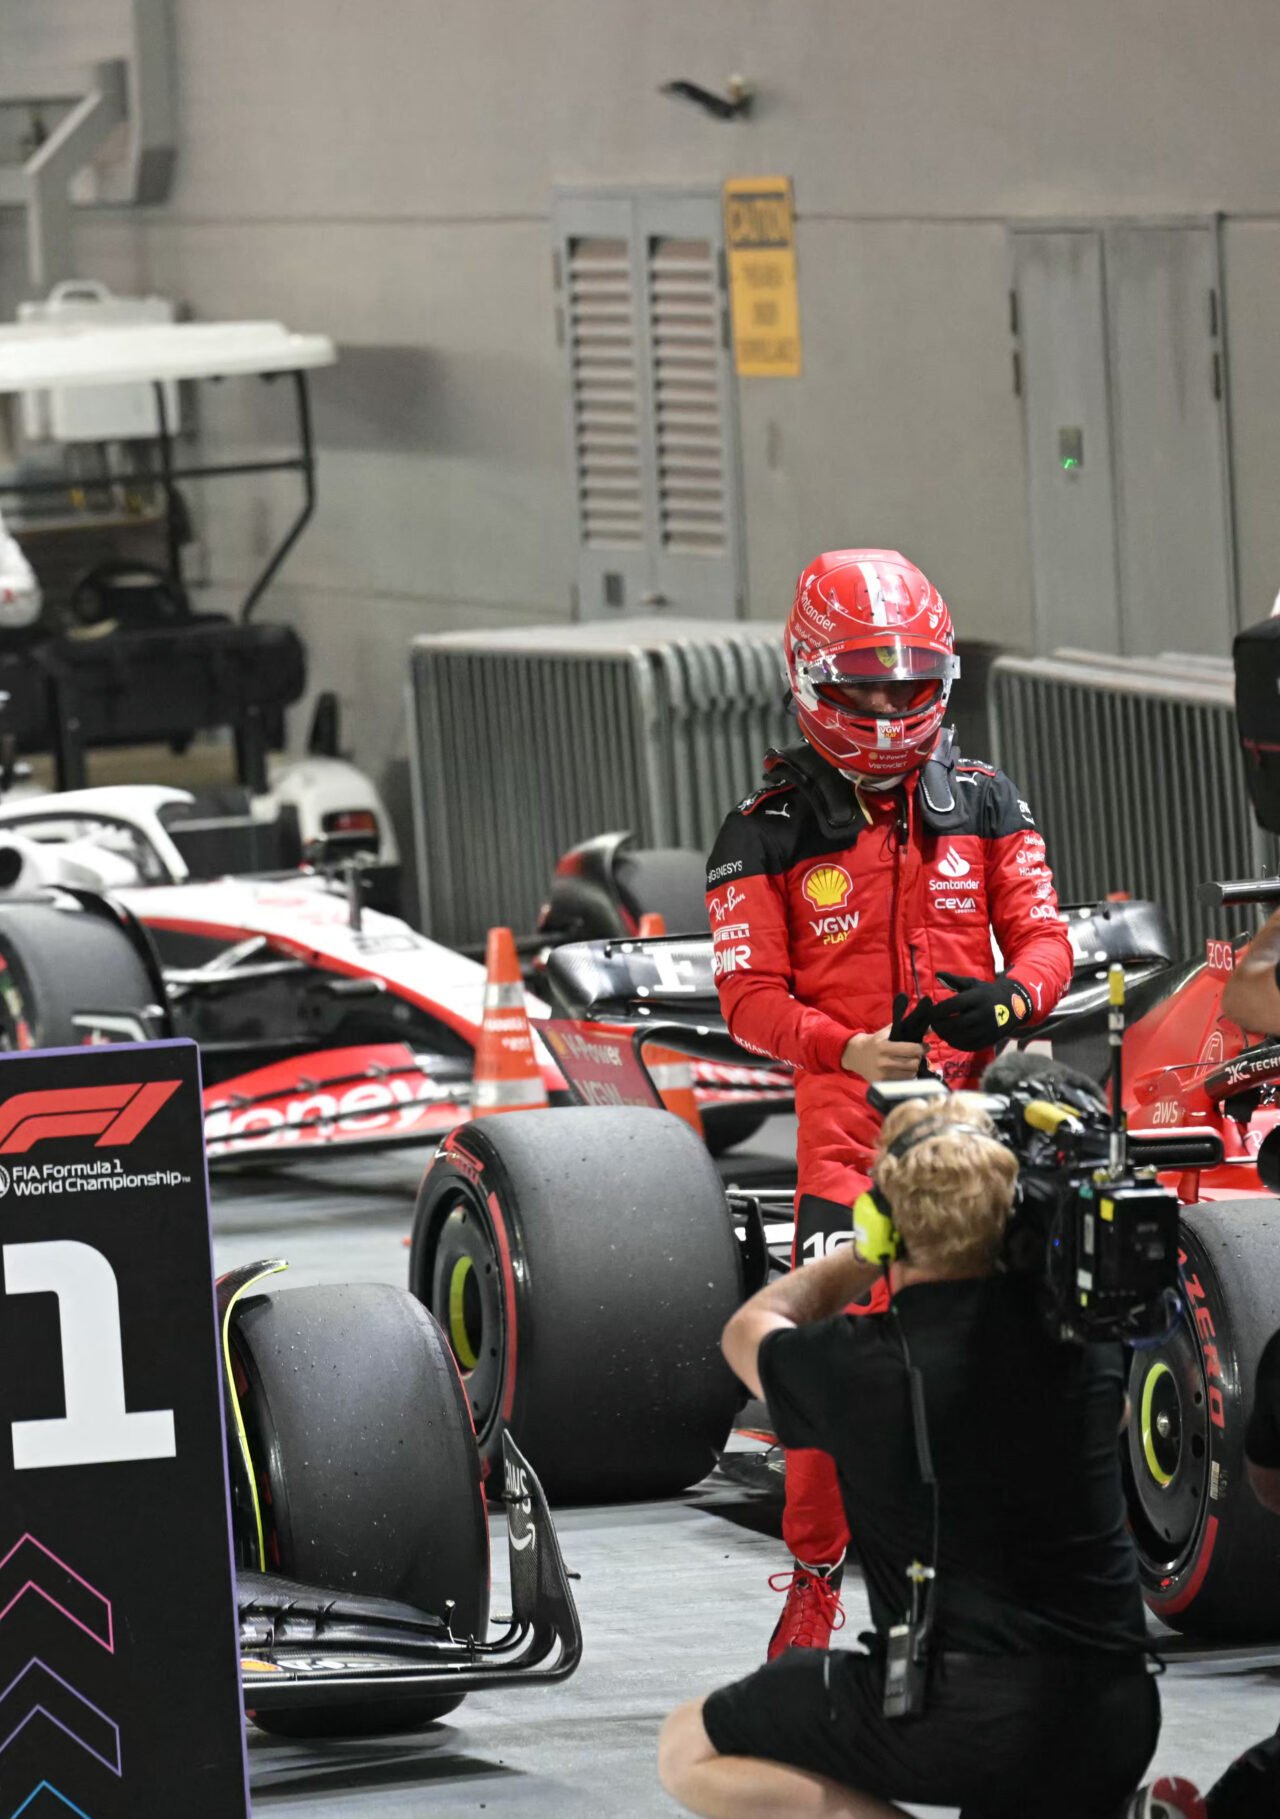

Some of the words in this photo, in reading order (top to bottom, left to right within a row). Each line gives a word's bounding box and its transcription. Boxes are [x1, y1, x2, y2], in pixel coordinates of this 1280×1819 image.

[880, 724, 901, 733] VGW
[711, 860, 743, 881] GENESYS
[928, 880, 980, 891] Santander
[809, 911, 860, 937] VGW
[823, 931, 850, 945] PLAY
[1207, 942, 1233, 971] ZCG
[1152, 1101, 1179, 1124] aws
[12, 1166, 41, 1180] FIA
[43, 1160, 111, 1178] Formula
[113, 1159, 124, 1173] 1
[13, 1175, 63, 1196] World
[3, 1239, 176, 1470] 1
[1183, 1274, 1226, 1428] ZERO
